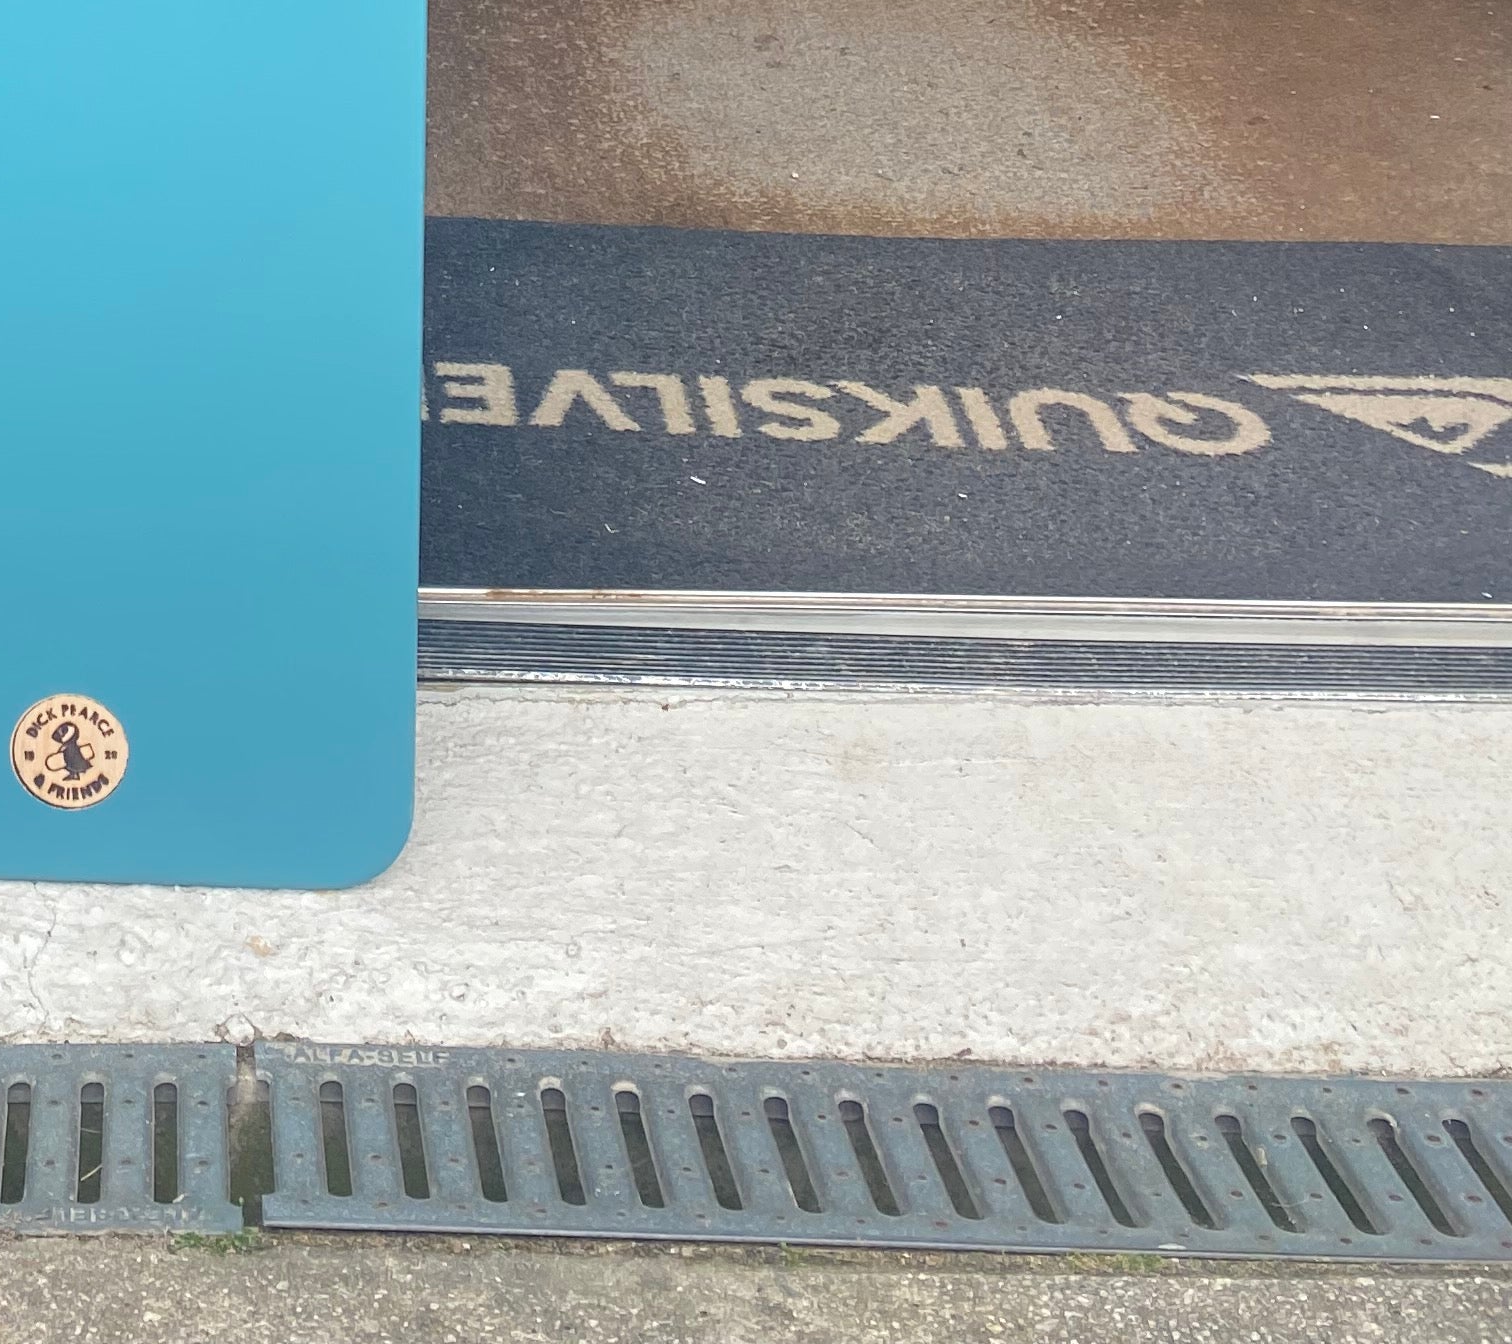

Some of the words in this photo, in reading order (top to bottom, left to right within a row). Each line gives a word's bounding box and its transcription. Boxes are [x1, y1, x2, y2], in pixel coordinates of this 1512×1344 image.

[424, 360, 1275, 457] QUIKSILVE
[25, 707, 58, 739] DICK
[61, 703, 115, 739] PEARCE
[47, 773, 109, 801] FRIENDS
